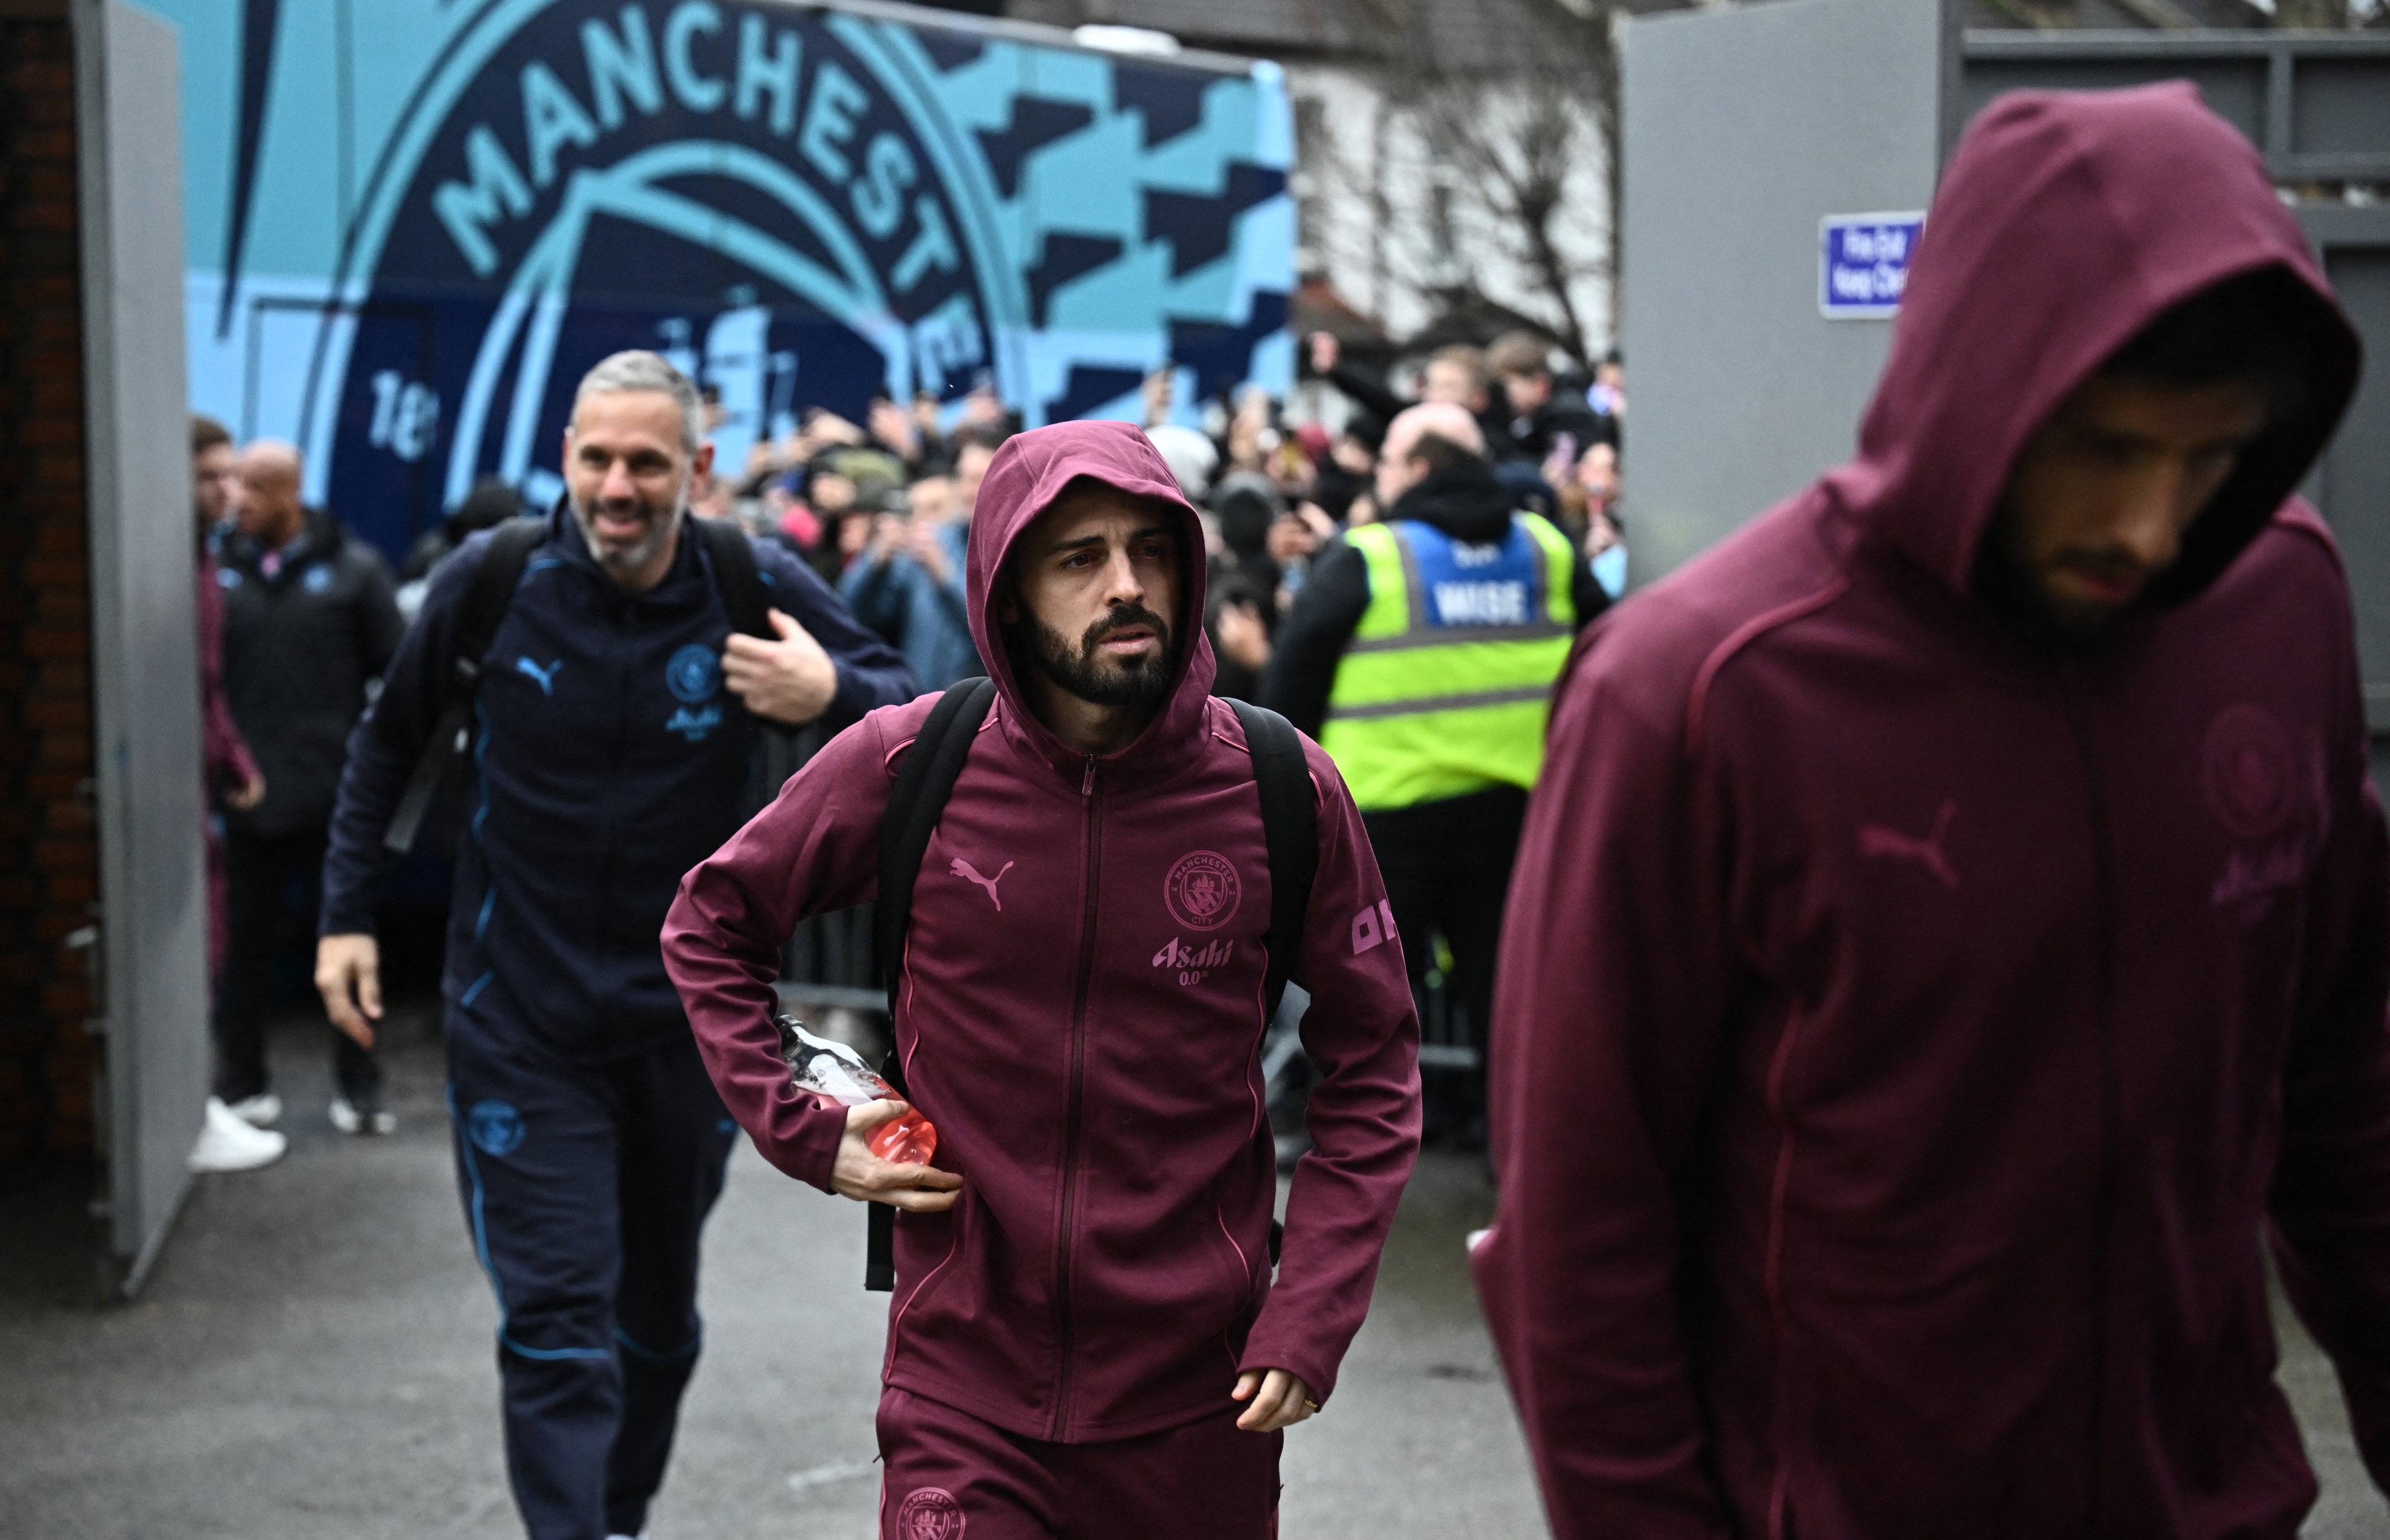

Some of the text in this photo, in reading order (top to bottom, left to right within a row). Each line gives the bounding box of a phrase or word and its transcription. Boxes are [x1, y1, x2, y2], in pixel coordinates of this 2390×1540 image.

[431, 0, 985, 429] MANCHESTE
[1434, 581, 1530, 625] WISE
[1174, 856, 1234, 884] MANCHESTER
[1191, 916, 1213, 925] CITY
[1152, 936, 1234, 968] Asahi
